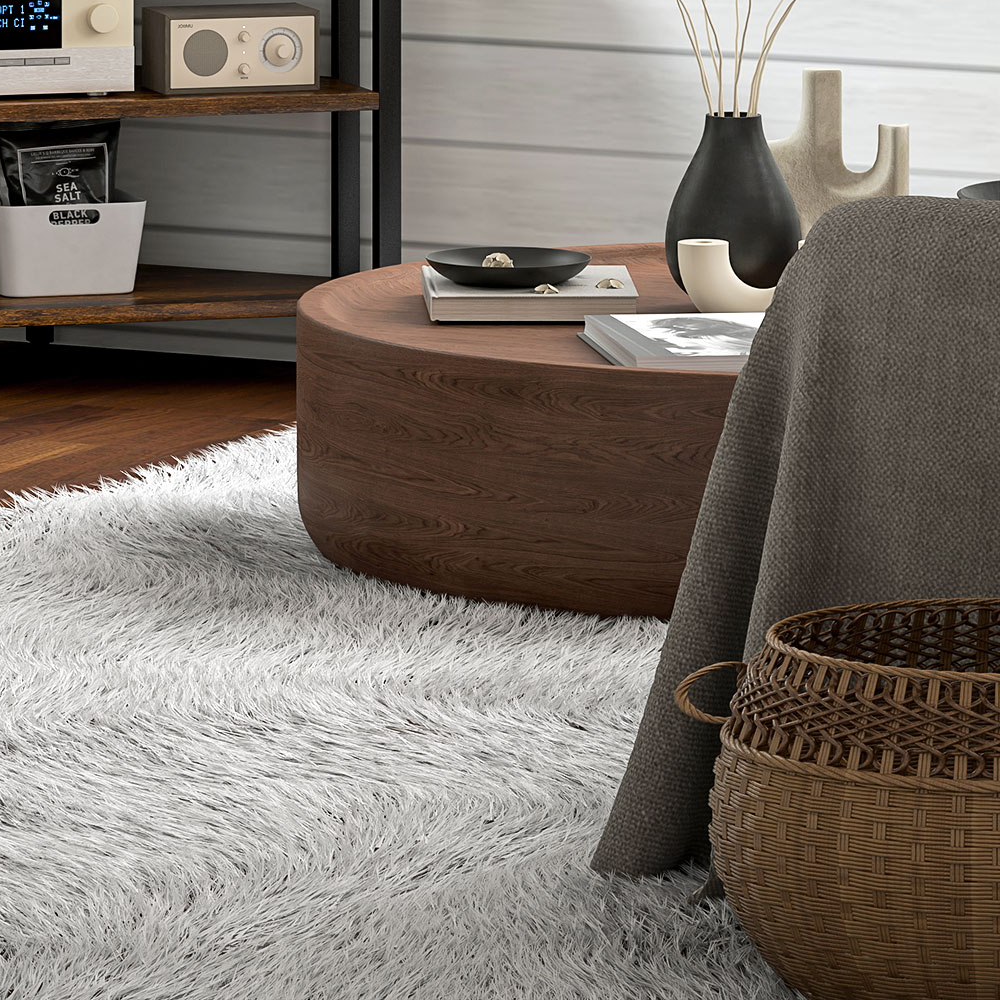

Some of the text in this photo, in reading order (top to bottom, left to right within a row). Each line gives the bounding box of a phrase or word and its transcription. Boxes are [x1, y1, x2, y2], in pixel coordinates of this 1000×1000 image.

[20, 5, 25, 14] 1
[13, 18, 25, 28] CI
[55, 181, 78, 193] SEA
[54, 191, 81, 203] SALT
[53, 209, 88, 220] BLACK
